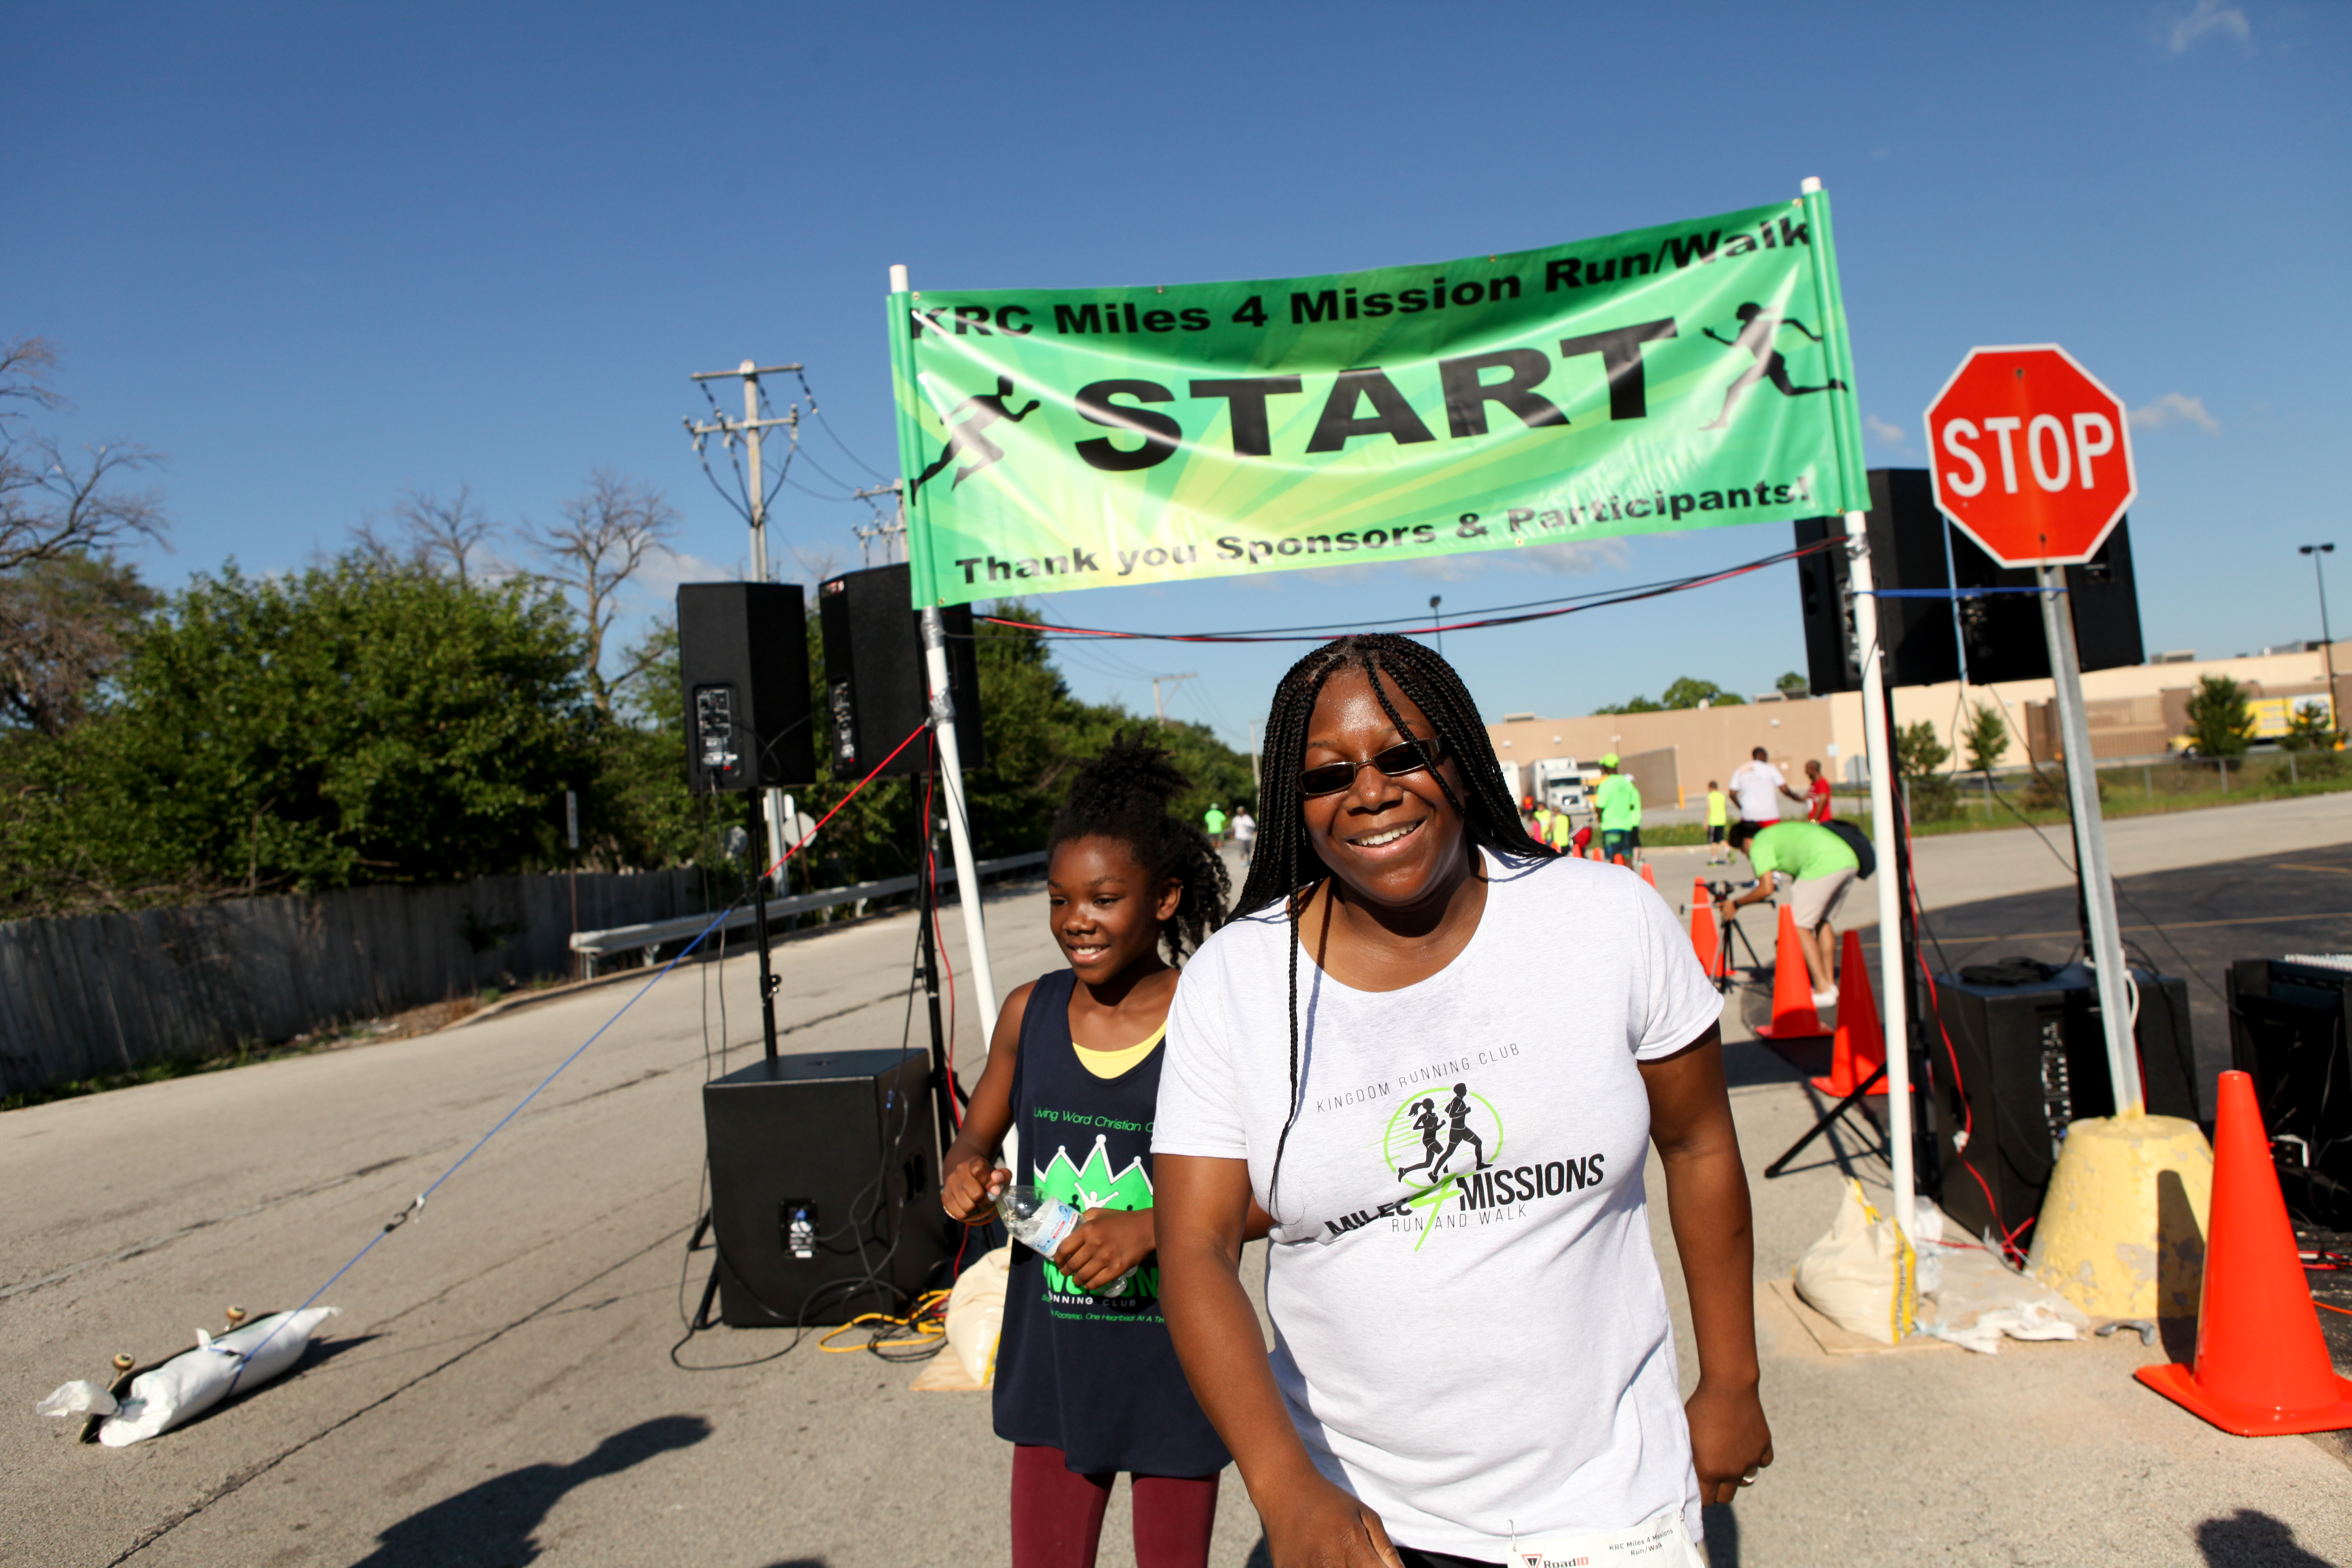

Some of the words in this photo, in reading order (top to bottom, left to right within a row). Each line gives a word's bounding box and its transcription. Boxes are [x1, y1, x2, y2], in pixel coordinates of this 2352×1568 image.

[910, 305, 1034, 340] KRC
[1053, 302, 1211, 334] Miles
[1232, 295, 1269, 327] 4
[1290, 276, 1521, 324] Mission
[1545, 217, 1810, 292] Run/Walk
[1075, 316, 1678, 471] START
[1942, 412, 2115, 498] STOP
[955, 547, 1099, 584] Thank
[1117, 544, 1197, 576] you
[1216, 522, 1436, 563] Sponsors
[1456, 513, 1489, 539] &
[1508, 477, 1810, 533] Participants!
[1317, 1082, 1390, 1113] KINGDOM
[1398, 1057, 1470, 1088] RUNNING
[1478, 1043, 1519, 1065] CLUB
[1034, 1107, 1059, 1122] Living
[1063, 1111, 1093, 1124] Word
[1095, 1116, 1142, 1131] Christian
[1456, 1153, 1605, 1211] MISSIONS
[1392, 1217, 1424, 1233] RUN
[1434, 1213, 1467, 1230] AND
[1479, 1203, 1527, 1225] WALK
[1627, 1540, 1645, 1548] Miles
[1630, 1541, 1663, 1556] Run/Walk
